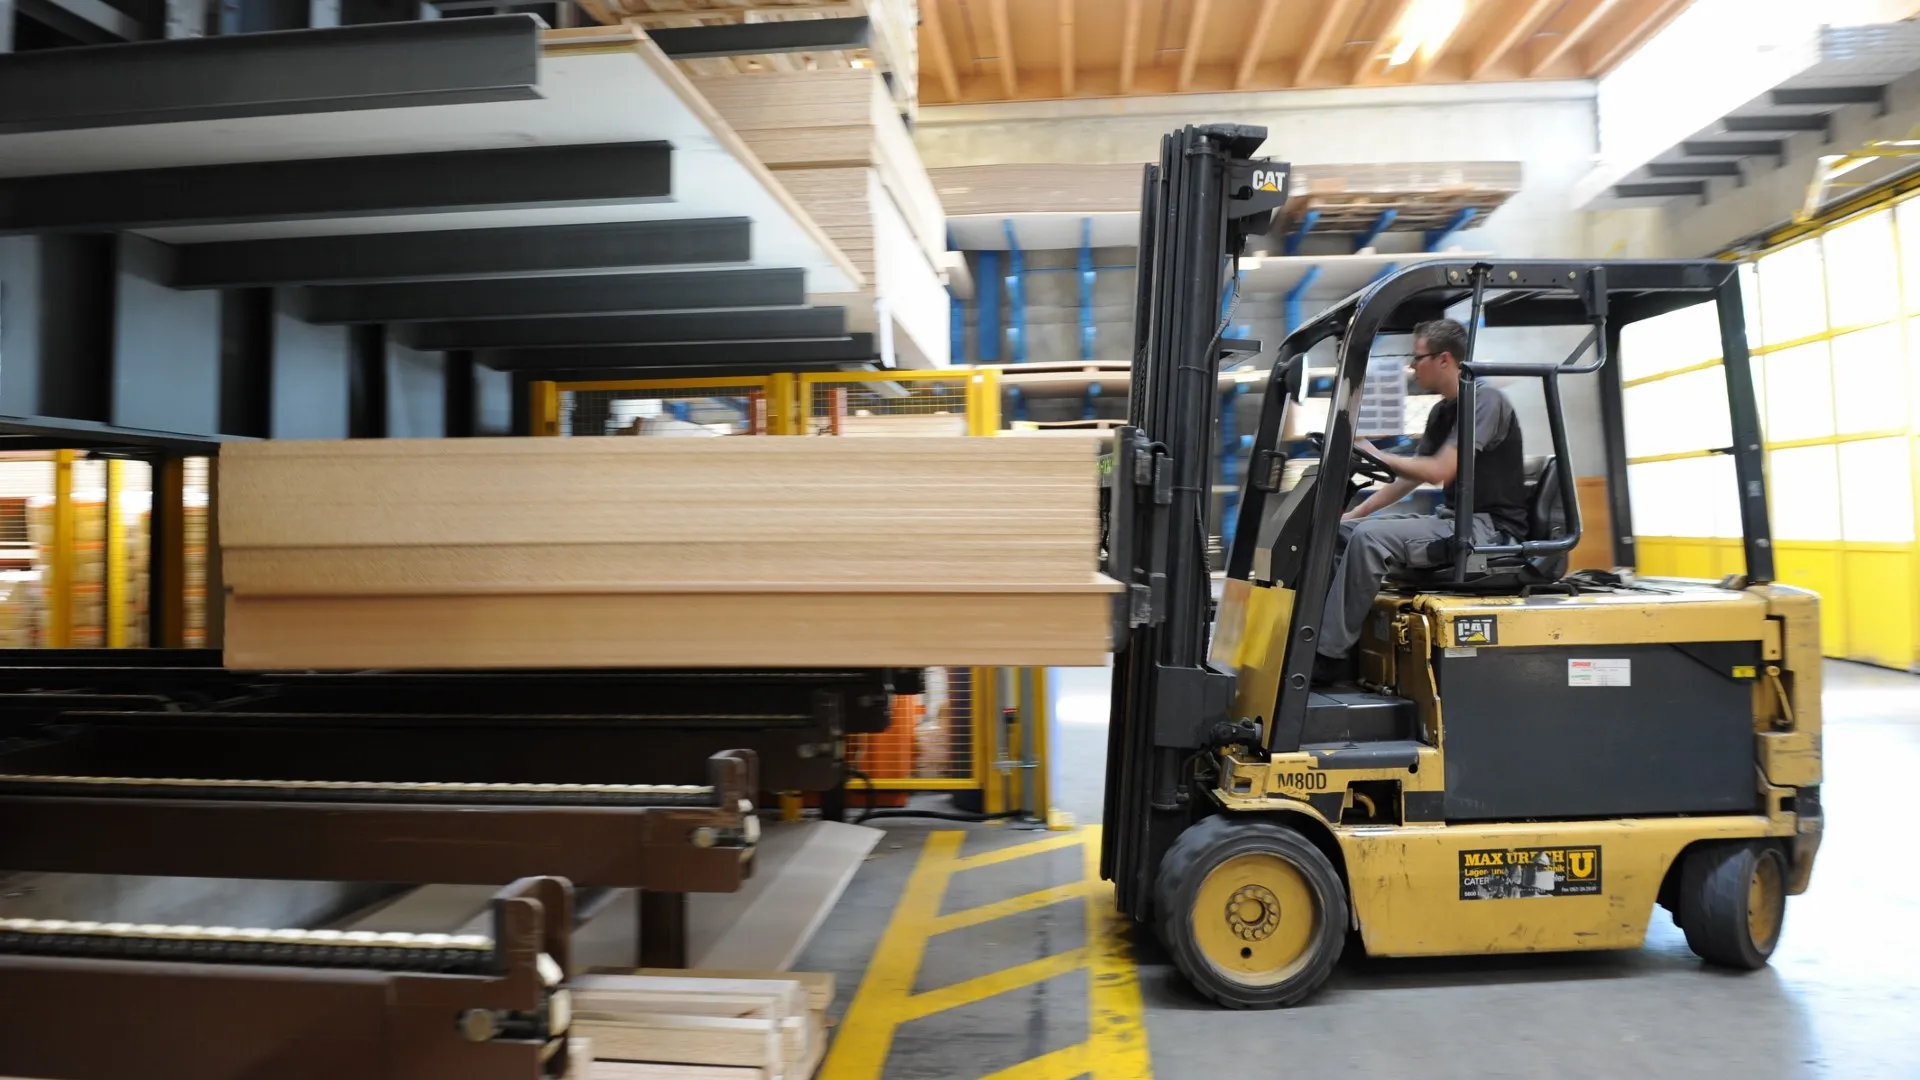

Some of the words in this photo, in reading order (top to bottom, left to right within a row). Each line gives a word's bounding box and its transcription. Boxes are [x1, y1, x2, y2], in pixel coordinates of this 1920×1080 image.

[1252, 170, 1286, 192] CAT
[1457, 619, 1493, 643] CAT
[1277, 773, 1327, 790] M80D
[1465, 853, 1502, 866] MAX
[1569, 852, 1594, 878] U
